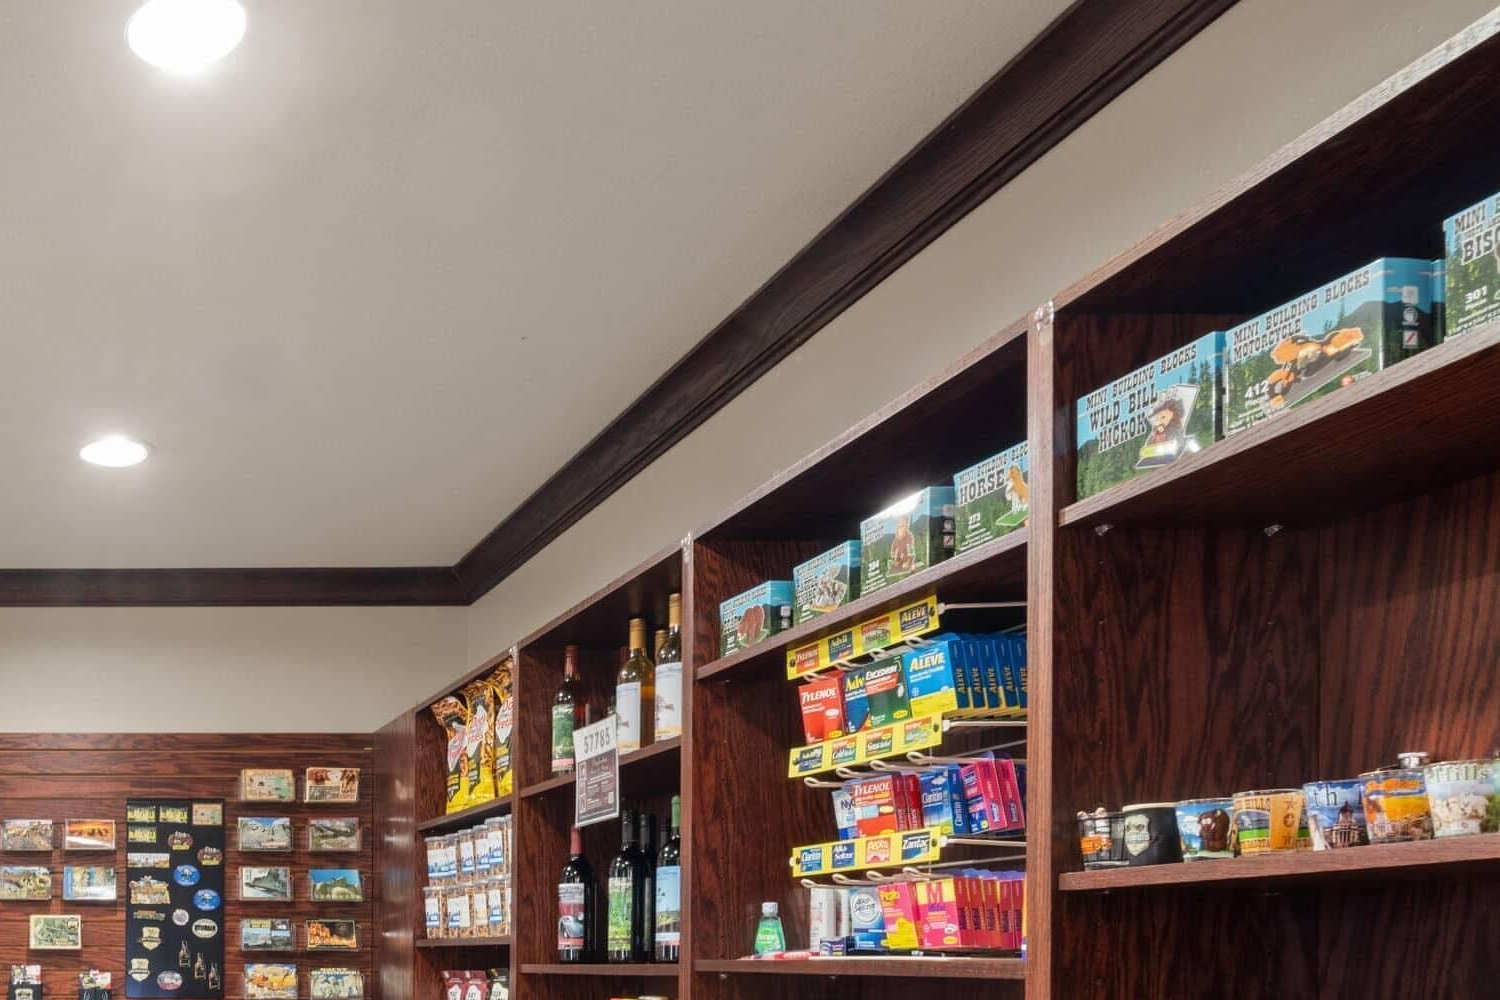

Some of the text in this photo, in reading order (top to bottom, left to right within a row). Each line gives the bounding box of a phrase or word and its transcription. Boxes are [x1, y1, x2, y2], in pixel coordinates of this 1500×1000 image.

[1455, 203, 1486, 234] MINI
[1465, 285, 1488, 304] 301
[1234, 270, 1370, 346] MINI BUILDING BLOCKS
[1234, 319, 1301, 361] MOTORCYCLE
[1086, 344, 1197, 410] MINI BUILDING BLOCKS
[1245, 380, 1269, 399] 412
[1089, 383, 1158, 432] WILD BILL
[959, 469, 1006, 506] HORSE
[902, 604, 927, 623] ALEVE
[909, 654, 946, 673] ALEVE
[800, 687, 838, 703] TYLENOL
[583, 728, 611, 754] 57785
[854, 781, 891, 796] TYLENOL
[902, 837, 929, 850] Zantac
